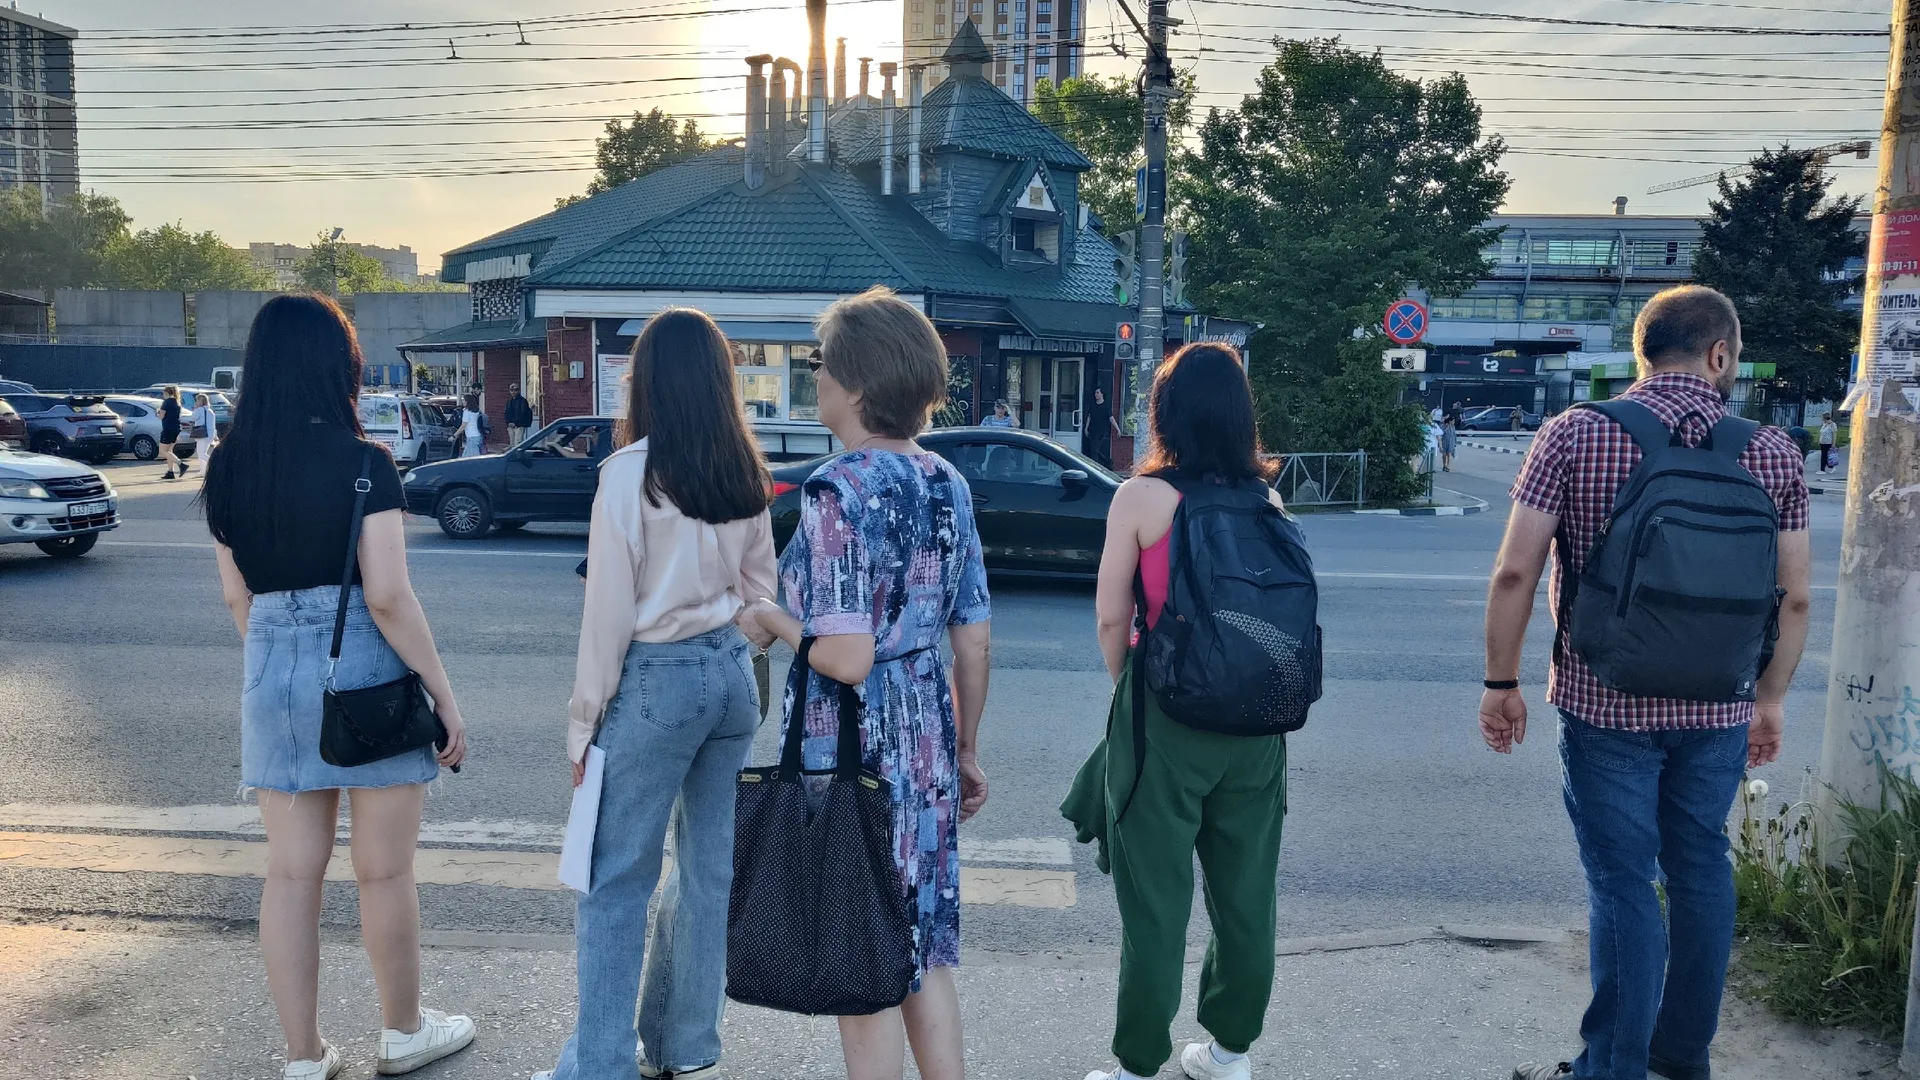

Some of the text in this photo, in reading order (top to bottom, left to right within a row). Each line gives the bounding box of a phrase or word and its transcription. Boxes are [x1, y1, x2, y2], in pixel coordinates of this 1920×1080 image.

[466, 253, 531, 283] ШАШЛЫК
[1872, 294, 1920, 311] СТРОИТЕЛЬ
[1483, 357, 1499, 372] t2
